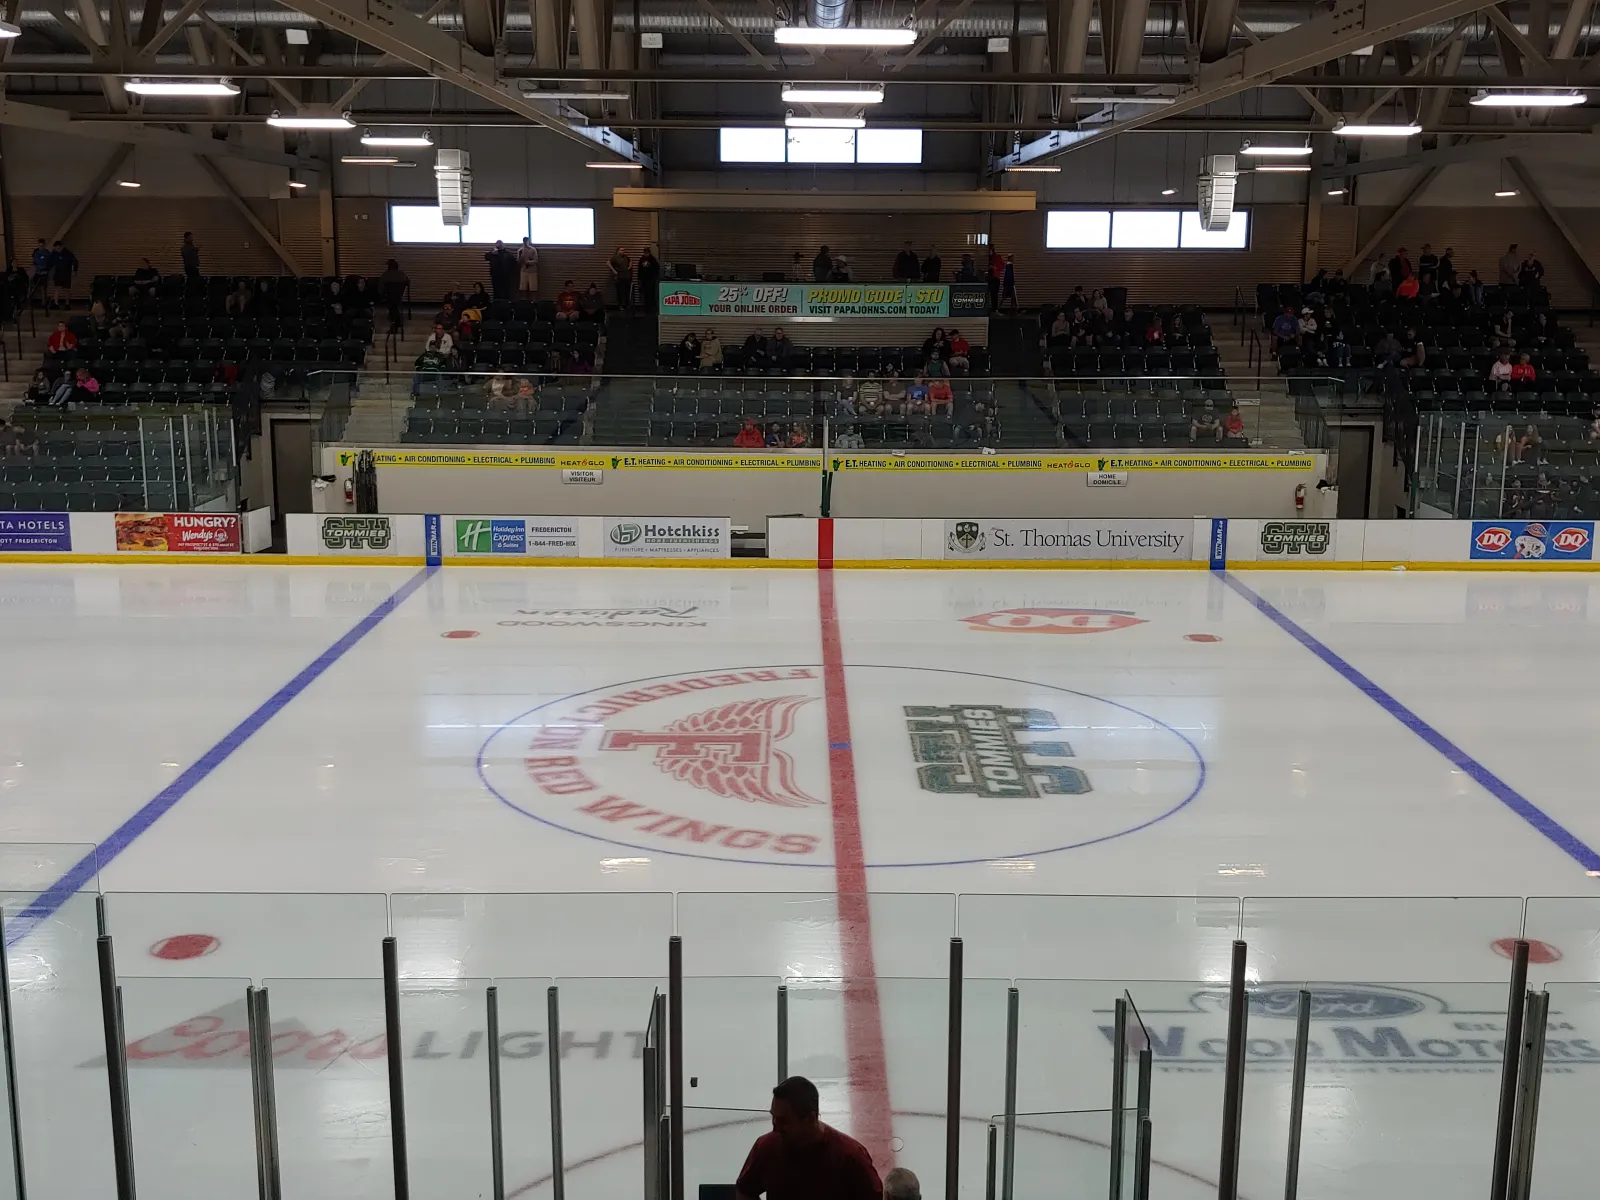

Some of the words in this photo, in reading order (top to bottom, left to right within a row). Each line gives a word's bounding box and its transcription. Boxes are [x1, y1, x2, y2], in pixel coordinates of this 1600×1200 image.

[664, 296, 680, 304] PAPA
[753, 287, 789, 302] OFF!
[808, 290, 861, 303] PROMO
[864, 290, 904, 303] CODE
[916, 290, 944, 303] STU
[709, 304, 732, 312] YOUR
[734, 304, 766, 313] ONLINE
[768, 304, 798, 314] ORDER
[809, 306, 832, 314] VISIT
[834, 306, 906, 314] PAPAJOHNS.COM
[909, 306, 940, 314] TODAY!
[473, 456, 513, 464] ELECTRICAL
[520, 456, 556, 464] PLUMBING
[624, 458, 637, 466] E.T.
[638, 458, 666, 466] HEATING
[686, 458, 733, 466] CONDITIONING
[786, 459, 820, 467] PLUMBING
[846, 459, 858, 468] E.T.
[859, 460, 886, 468] HEATING
[18, 520, 65, 530] HOTELS
[174, 516, 236, 528] HUNGRY?
[182, 528, 214, 542] Wendy's
[322, 517, 392, 550] STU
[326, 529, 386, 538] TOMMIES
[644, 524, 720, 537] Hotchkiss
[493, 534, 524, 542] Express
[993, 529, 1014, 547] St.
[1020, 529, 1092, 547] Thomas
[1096, 529, 1184, 552] University
[1261, 522, 1330, 554] STU
[1266, 534, 1326, 542] TOMMIES
[1482, 534, 1506, 546] DQ
[1559, 534, 1584, 546] DQ
[962, 708, 1024, 792] TOMMIES
[524, 756, 600, 795] RED
[573, 794, 821, 854] WINGS
[1331, 1026, 1600, 1058] MOTRS
